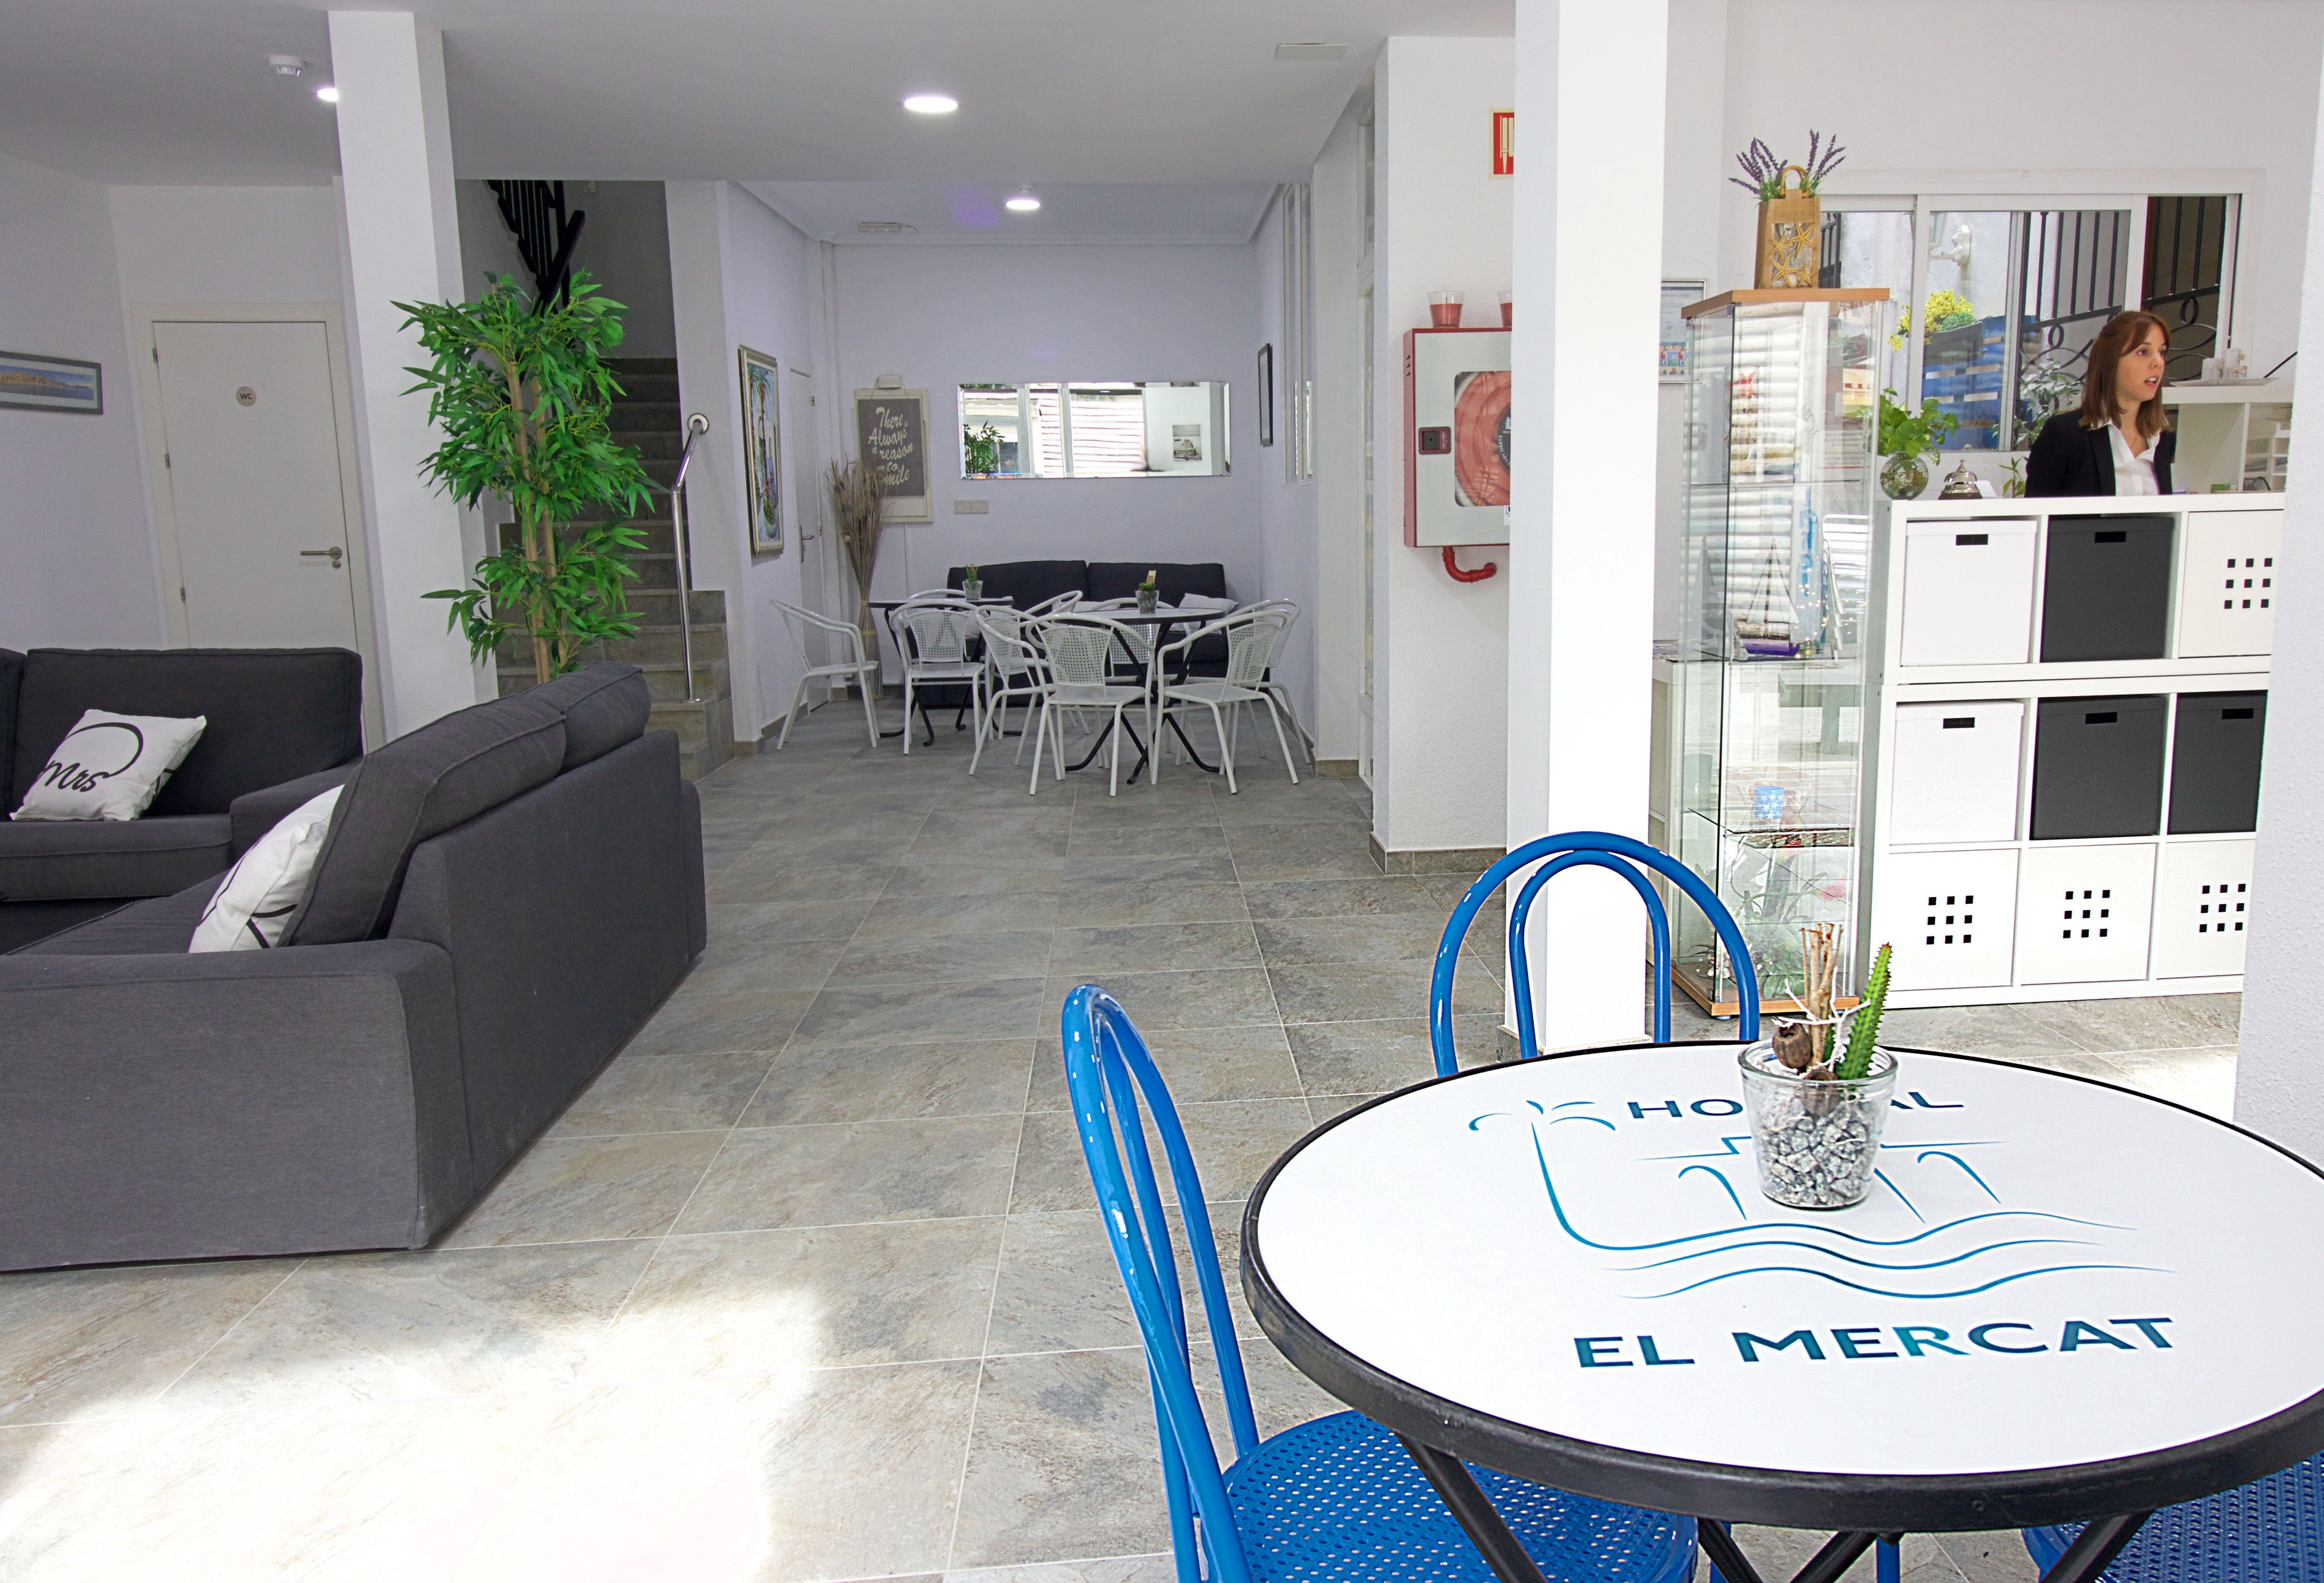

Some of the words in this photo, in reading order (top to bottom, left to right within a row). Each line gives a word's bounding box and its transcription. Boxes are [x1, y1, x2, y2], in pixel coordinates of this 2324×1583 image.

[876, 407, 904, 429] There
[868, 427, 907, 447] Always
[879, 443, 914, 460] reason
[882, 465, 910, 485] mile
[887, 461, 899, 472] to
[39, 760, 110, 792] Mrs
[1575, 1335, 1696, 1368] EL
[1732, 1317, 2173, 1363] MERCAT
